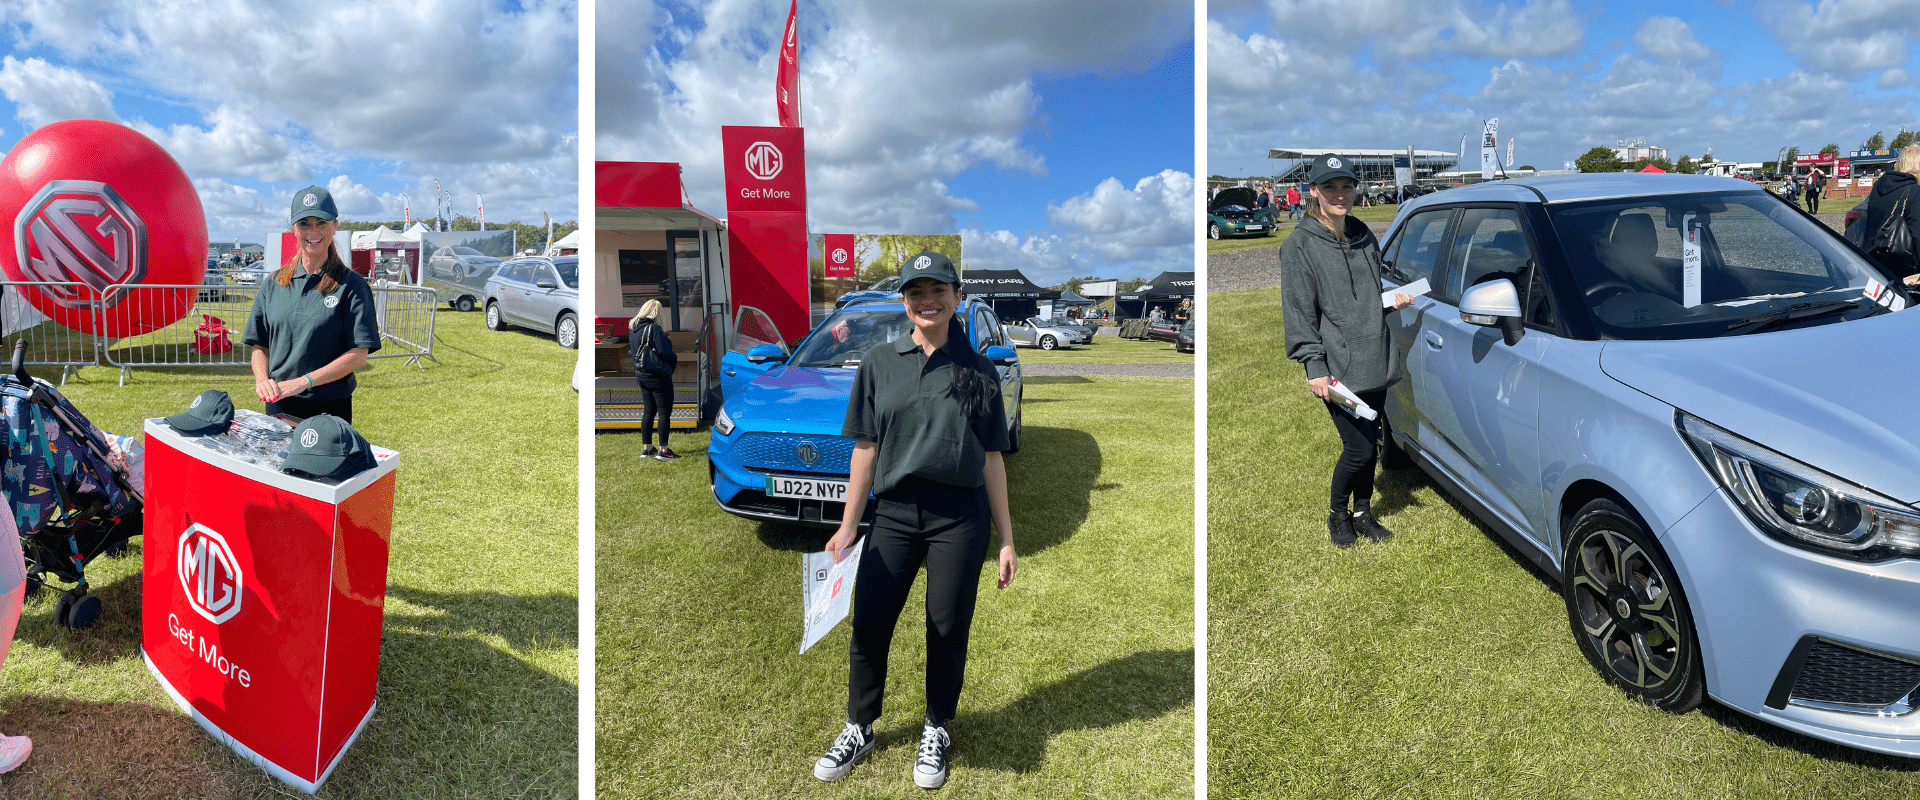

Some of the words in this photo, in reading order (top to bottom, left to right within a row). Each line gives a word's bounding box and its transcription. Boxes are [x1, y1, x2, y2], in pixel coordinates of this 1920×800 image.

[747, 144, 780, 177] MG
[741, 187, 760, 198] Get
[763, 187, 790, 198] More
[22, 189, 138, 302] MG
[833, 249, 847, 262] MG
[1685, 248, 1695, 256] Get
[915, 256, 931, 268] MG
[301, 430, 317, 446] MG
[797, 442, 818, 463] MG
[774, 479, 812, 497] LD22
[817, 482, 846, 499] NYP
[181, 529, 238, 618] MG
[168, 613, 195, 652] Get
[199, 635, 251, 688] More
